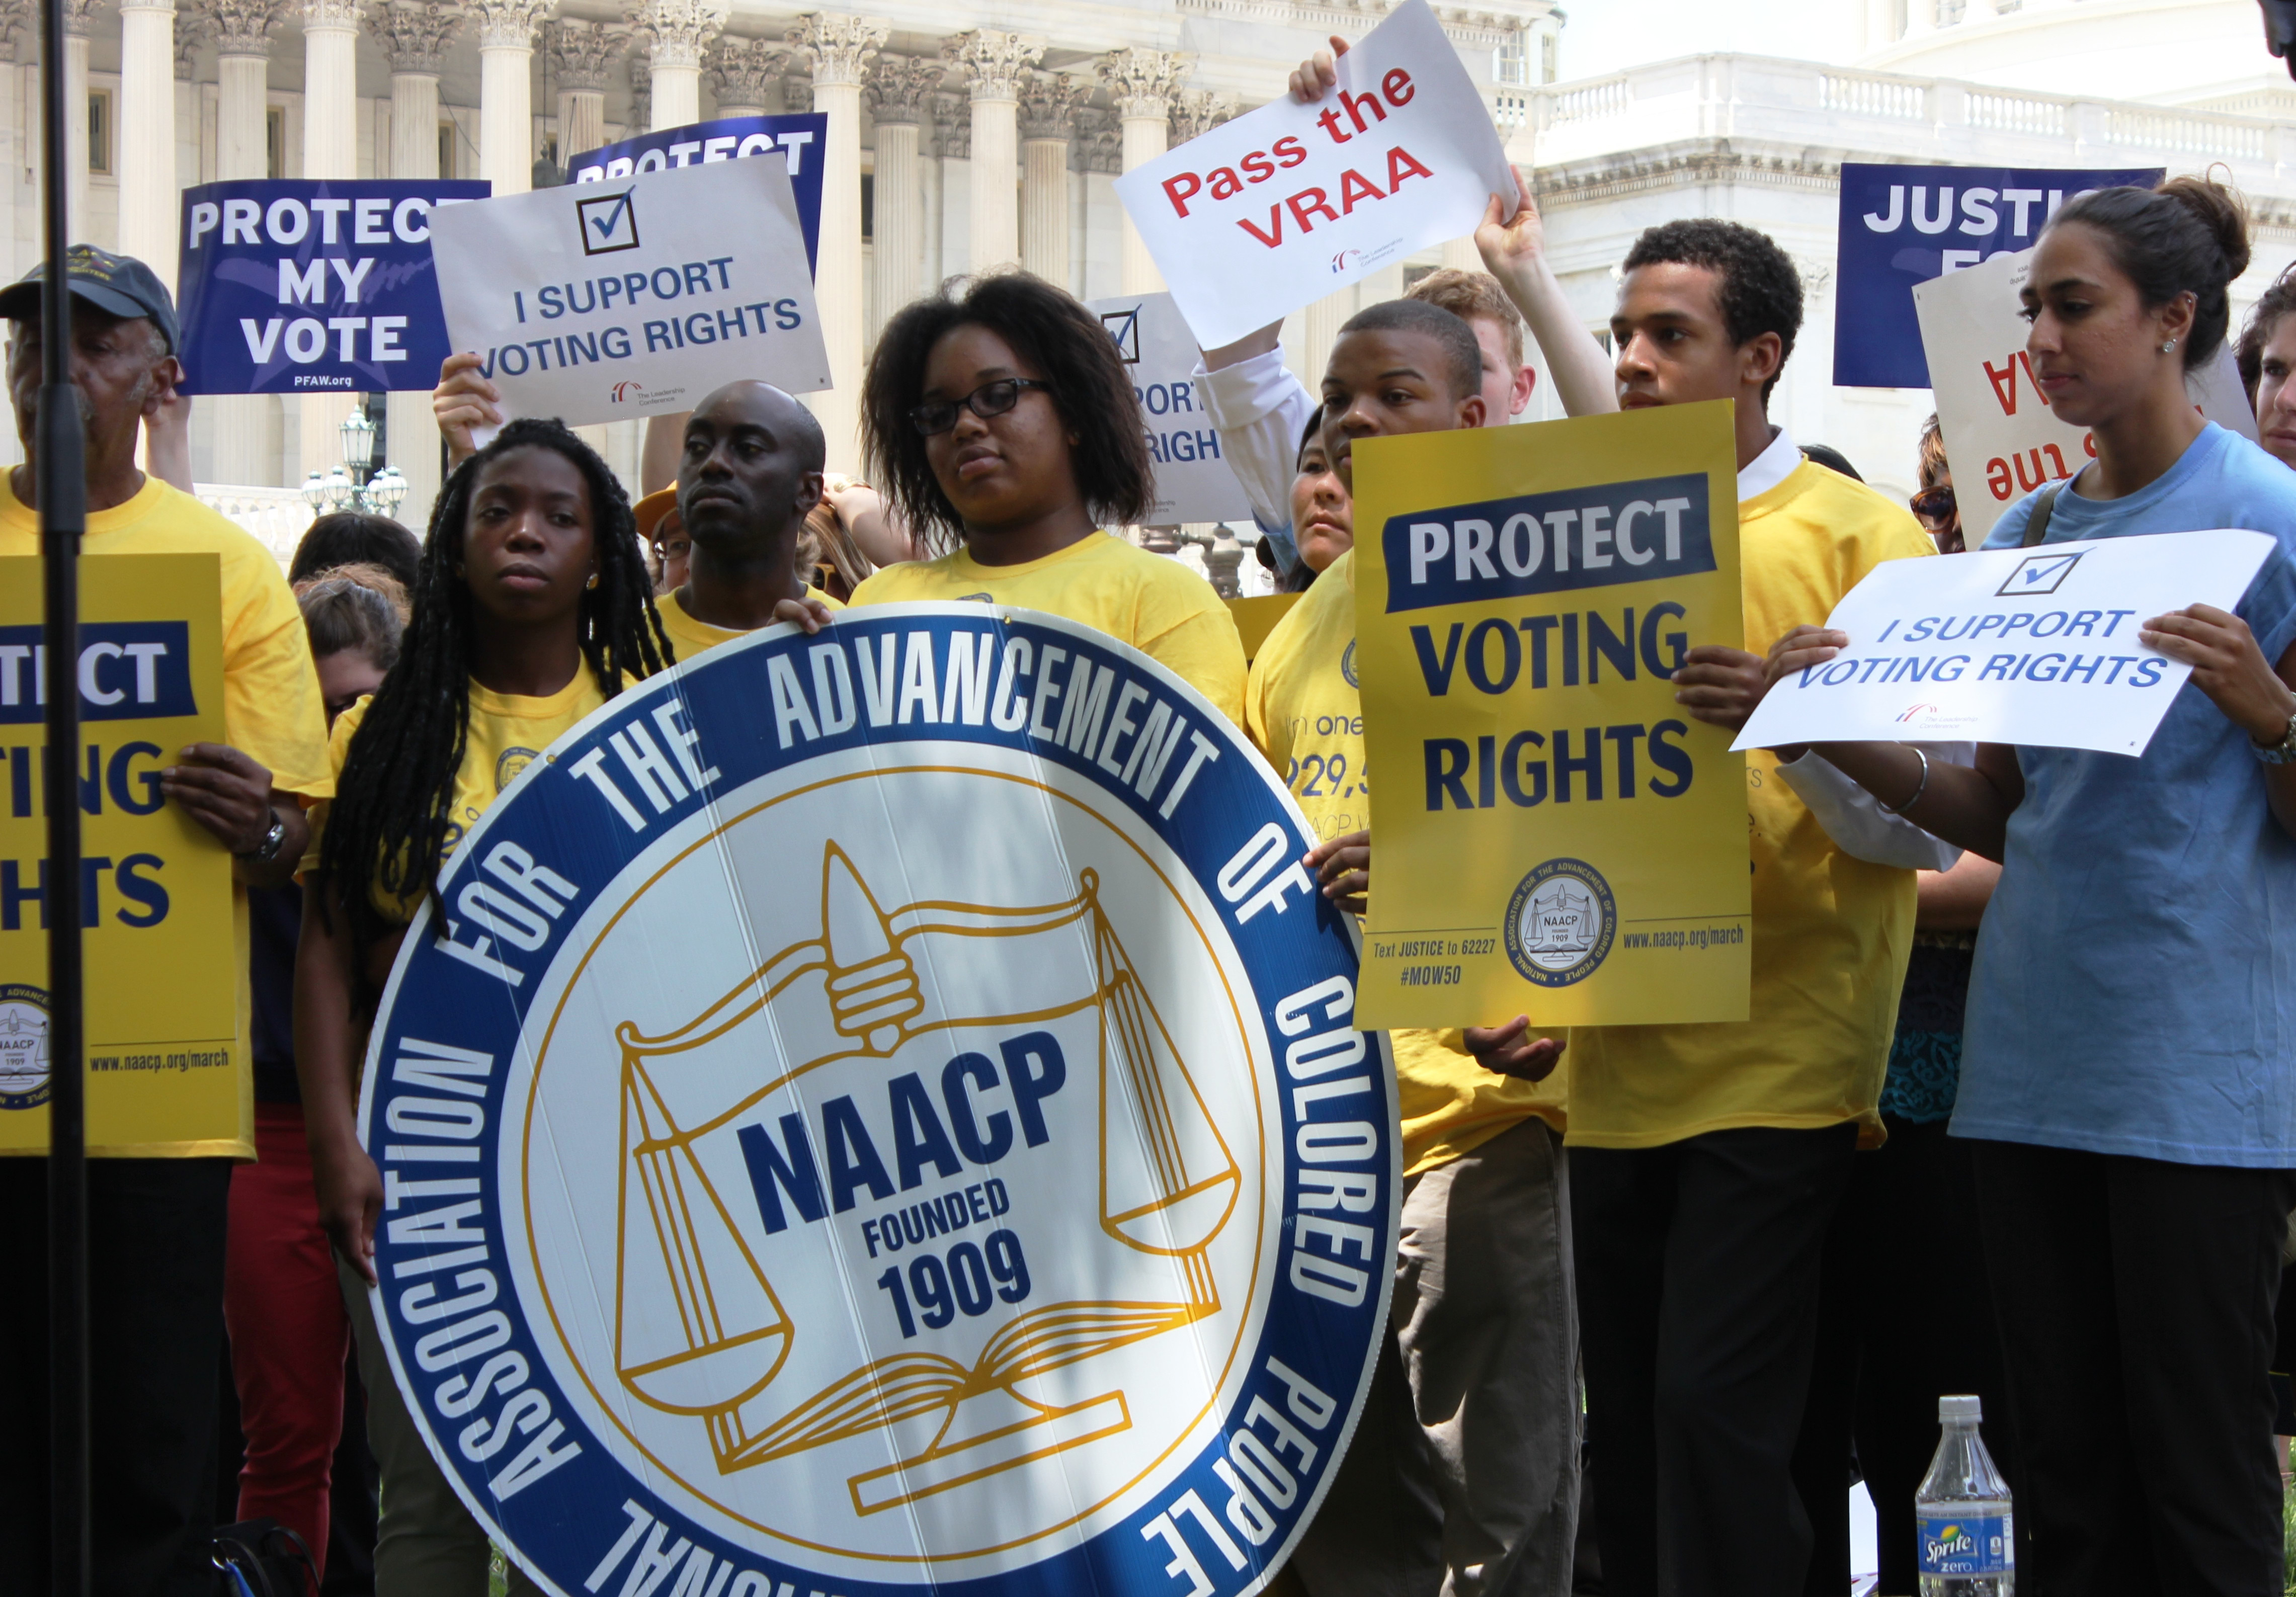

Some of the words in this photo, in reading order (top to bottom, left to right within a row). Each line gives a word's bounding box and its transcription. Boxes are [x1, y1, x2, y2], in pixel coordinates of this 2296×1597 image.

[1161, 135, 1307, 219] Pass
[1316, 67, 1416, 144] the
[1236, 145, 1434, 249] VRAA
[189, 197, 475, 249] PROTEC
[278, 258, 375, 304] MY
[514, 290, 526, 323] I
[537, 256, 734, 320] SUPPORT
[239, 315, 407, 364] VOTE
[467, 327, 632, 379] VOTING
[643, 298, 801, 353] RIGHTS
[294, 376, 352, 388] PFAW.org
[638, 396, 675, 406] Conference
[651, 387, 685, 397] Leadership
[1410, 497, 1690, 584] PROTECT
[1409, 601, 1689, 697] VOTING
[1876, 619, 1901, 643] I
[1902, 609, 2136, 643] SUPPORT
[1797, 655, 1973, 690] VOTING
[1977, 652, 2168, 689] RIGHTS
[766, 630, 1220, 821] ADVANCEMENT
[567, 697, 722, 833] THE
[1423, 718, 1693, 811] RIGHTS
[1216, 821, 1313, 926] OF
[1522, 876, 1536, 892] FOR
[1538, 864, 1553, 878] THE
[1557, 862, 1607, 896] ADVANCEMENT
[433, 839, 580, 988] FOR
[1508, 893, 1523, 951] ASSOCIATION
[1544, 915, 1578, 926] NAACP
[1604, 900, 1612, 911] OF
[1374, 941, 1396, 958] Text
[1399, 940, 1443, 957] JUSTICE
[1447, 939, 1457, 956] to
[1461, 938, 1496, 956] 62227
[1551, 934, 1569, 942] 1909
[1595, 917, 1612, 958] COLORED
[1623, 923, 1744, 951] www.naacp.org/march
[1400, 965, 1461, 986] #MOW50
[1515, 953, 1548, 982] NATIONAL
[1565, 958, 1595, 981] PEOPLE
[90, 1048, 229, 1073] www.naacp.org/march
[736, 1031, 1067, 1235] NAACP
[1275, 974, 1378, 1308] COLORED
[861, 1178, 1010, 1259] FOUNDED
[384, 1036, 583, 1503] ASSOCIATION
[877, 1229, 1031, 1339] 1909
[1140, 1355, 1337, 1597] PEOPLE
[1926, 1532, 1972, 1564] Sprite
[1940, 1561, 1972, 1572] zero
